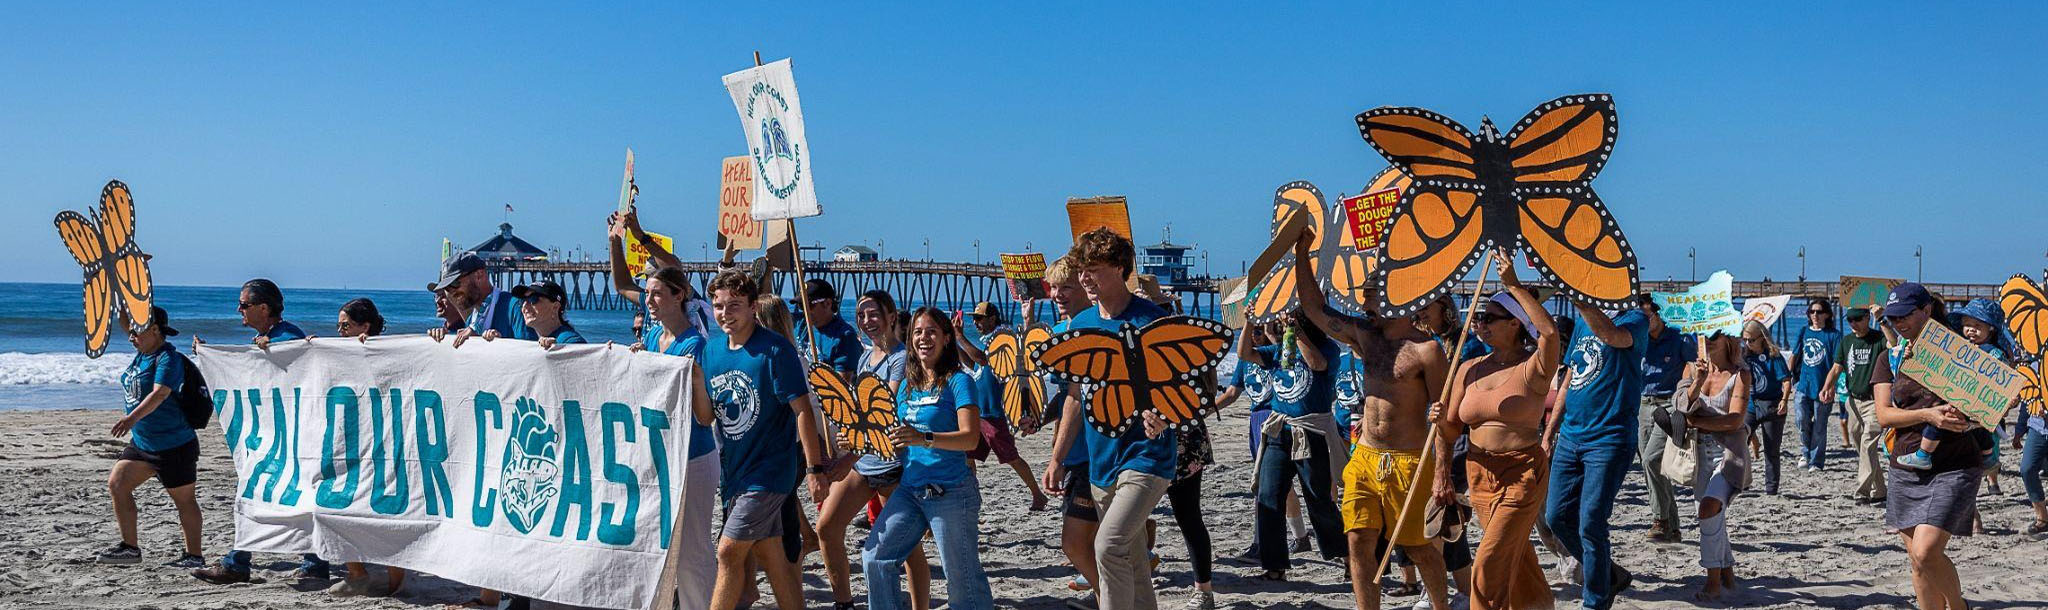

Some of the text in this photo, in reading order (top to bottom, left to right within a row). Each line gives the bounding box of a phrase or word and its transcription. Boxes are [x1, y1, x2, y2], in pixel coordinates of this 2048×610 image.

[747, 82, 788, 119] HEAL OUR COAST
[724, 161, 752, 183] HEAL
[723, 186, 749, 207] OUR
[1378, 191, 1397, 205] THE
[1358, 205, 1393, 223] DOUGH
[1358, 223, 1372, 236] TO
[1375, 219, 1387, 232] ST
[1355, 235, 1376, 249] THE
[1667, 296, 1698, 304] HEAL
[1921, 321, 2018, 389] HEAL OUR COAST
[1977, 384, 2009, 412] COSTA
[315, 385, 454, 519] OUR
